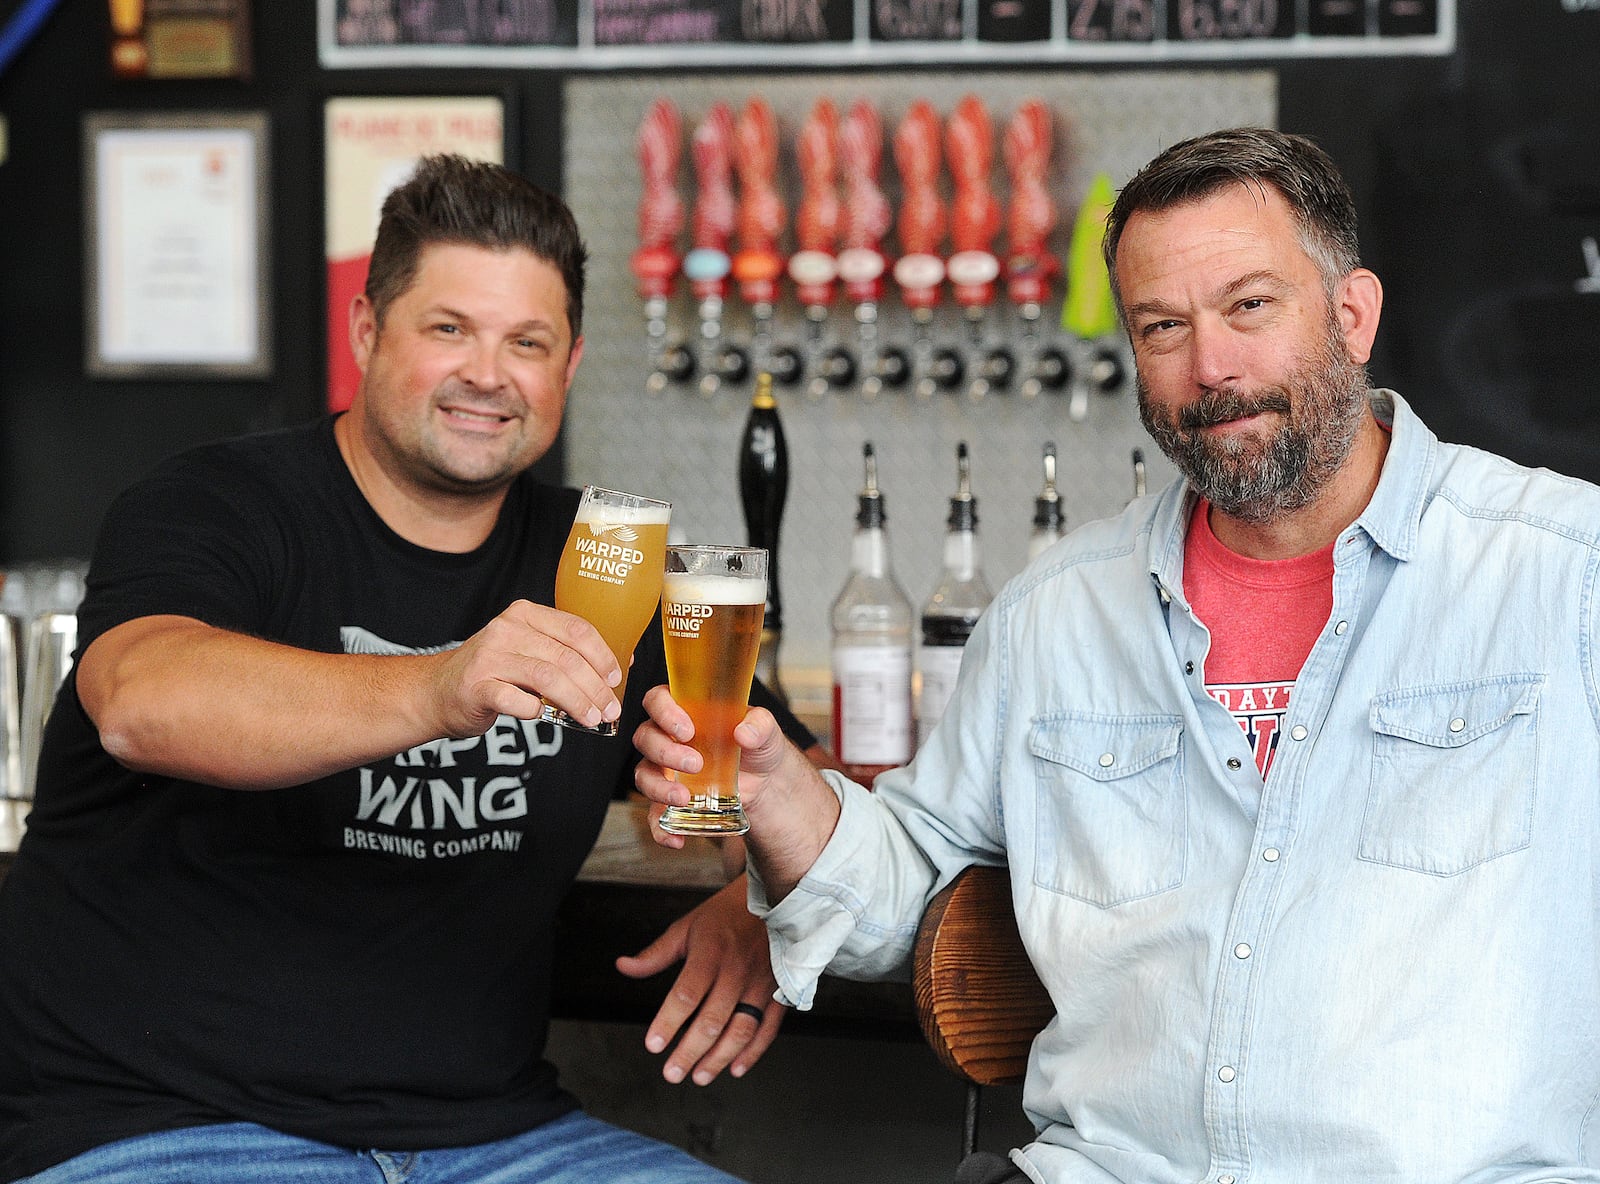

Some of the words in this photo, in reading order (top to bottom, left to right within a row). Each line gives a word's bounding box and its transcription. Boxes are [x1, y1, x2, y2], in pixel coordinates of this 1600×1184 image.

[575, 537, 644, 565] WARPED
[600, 575, 625, 586] COMPANY
[343, 827, 426, 859] BREWING
[432, 830, 524, 858] COMPANY
